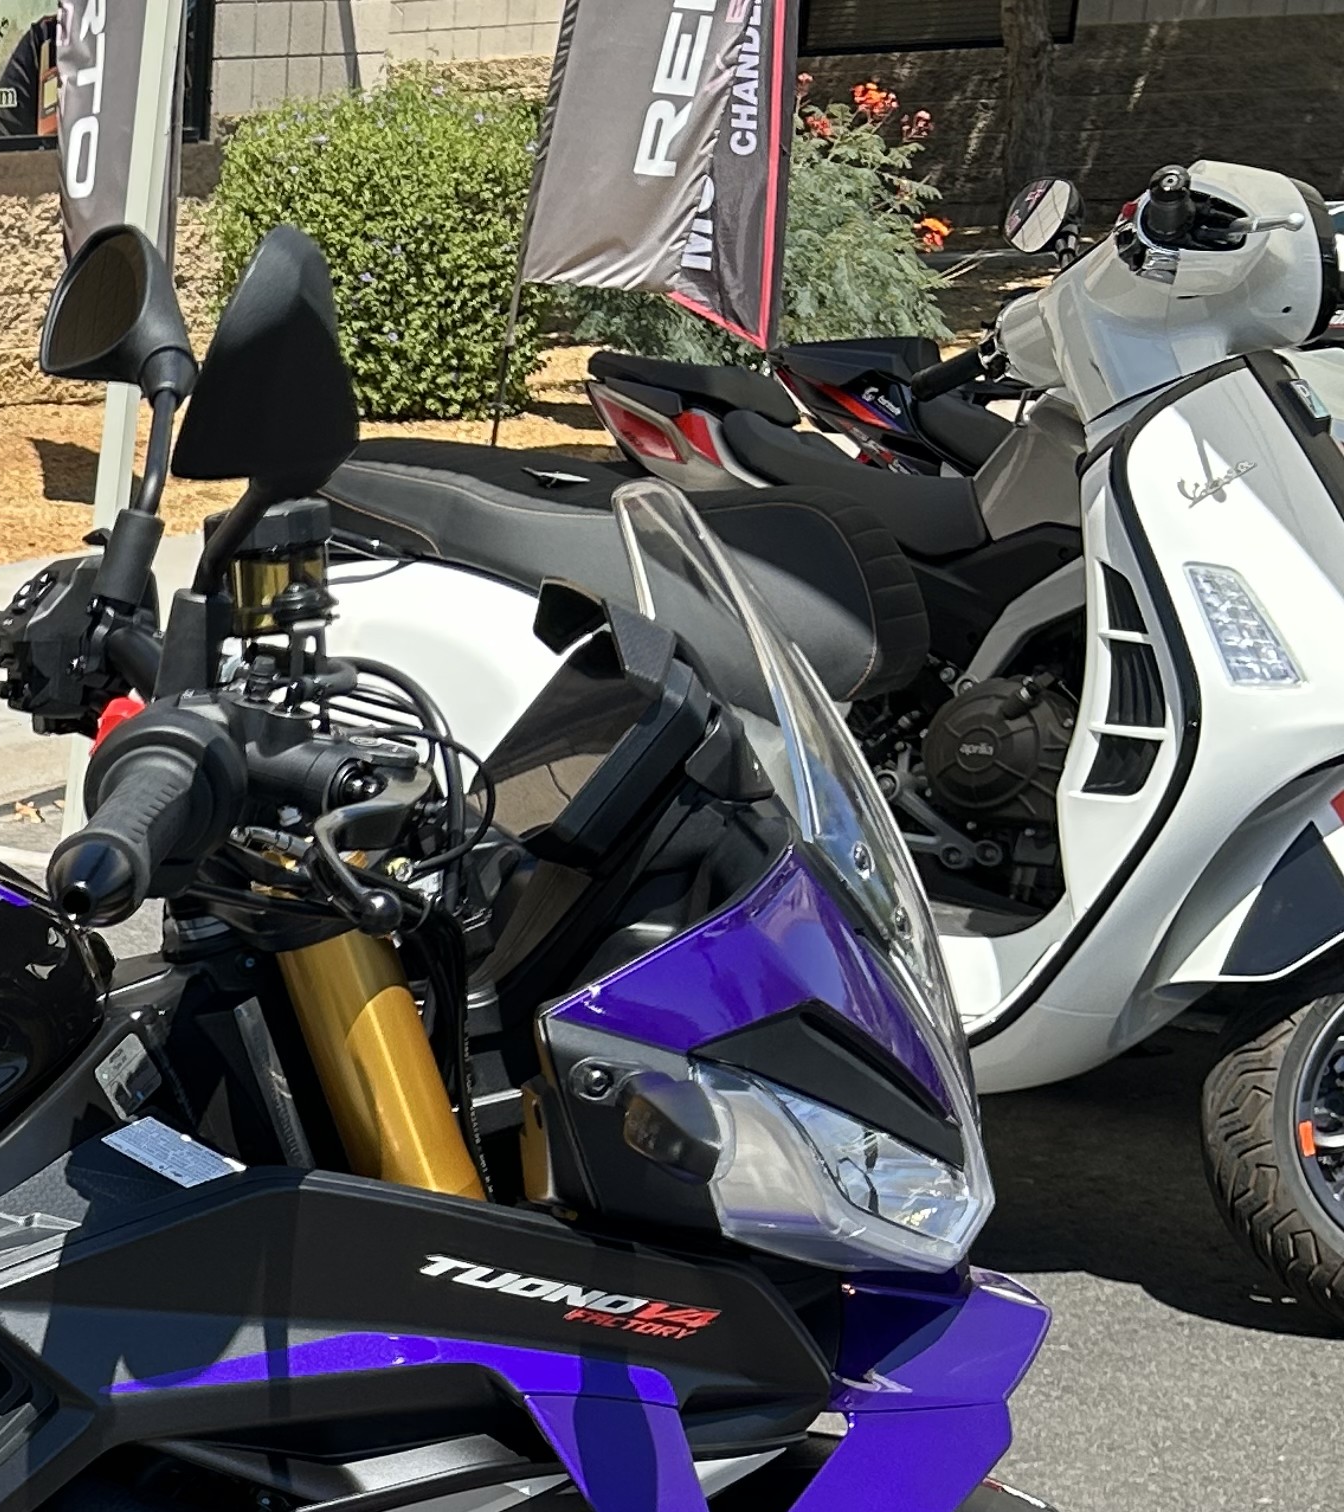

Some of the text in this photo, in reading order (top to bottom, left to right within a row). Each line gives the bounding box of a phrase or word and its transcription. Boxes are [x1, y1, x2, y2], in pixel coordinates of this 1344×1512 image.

[633, 0, 716, 177] RE
[418, 1253, 722, 1330] TUONO V4
[562, 1308, 698, 1341] FACTORY
